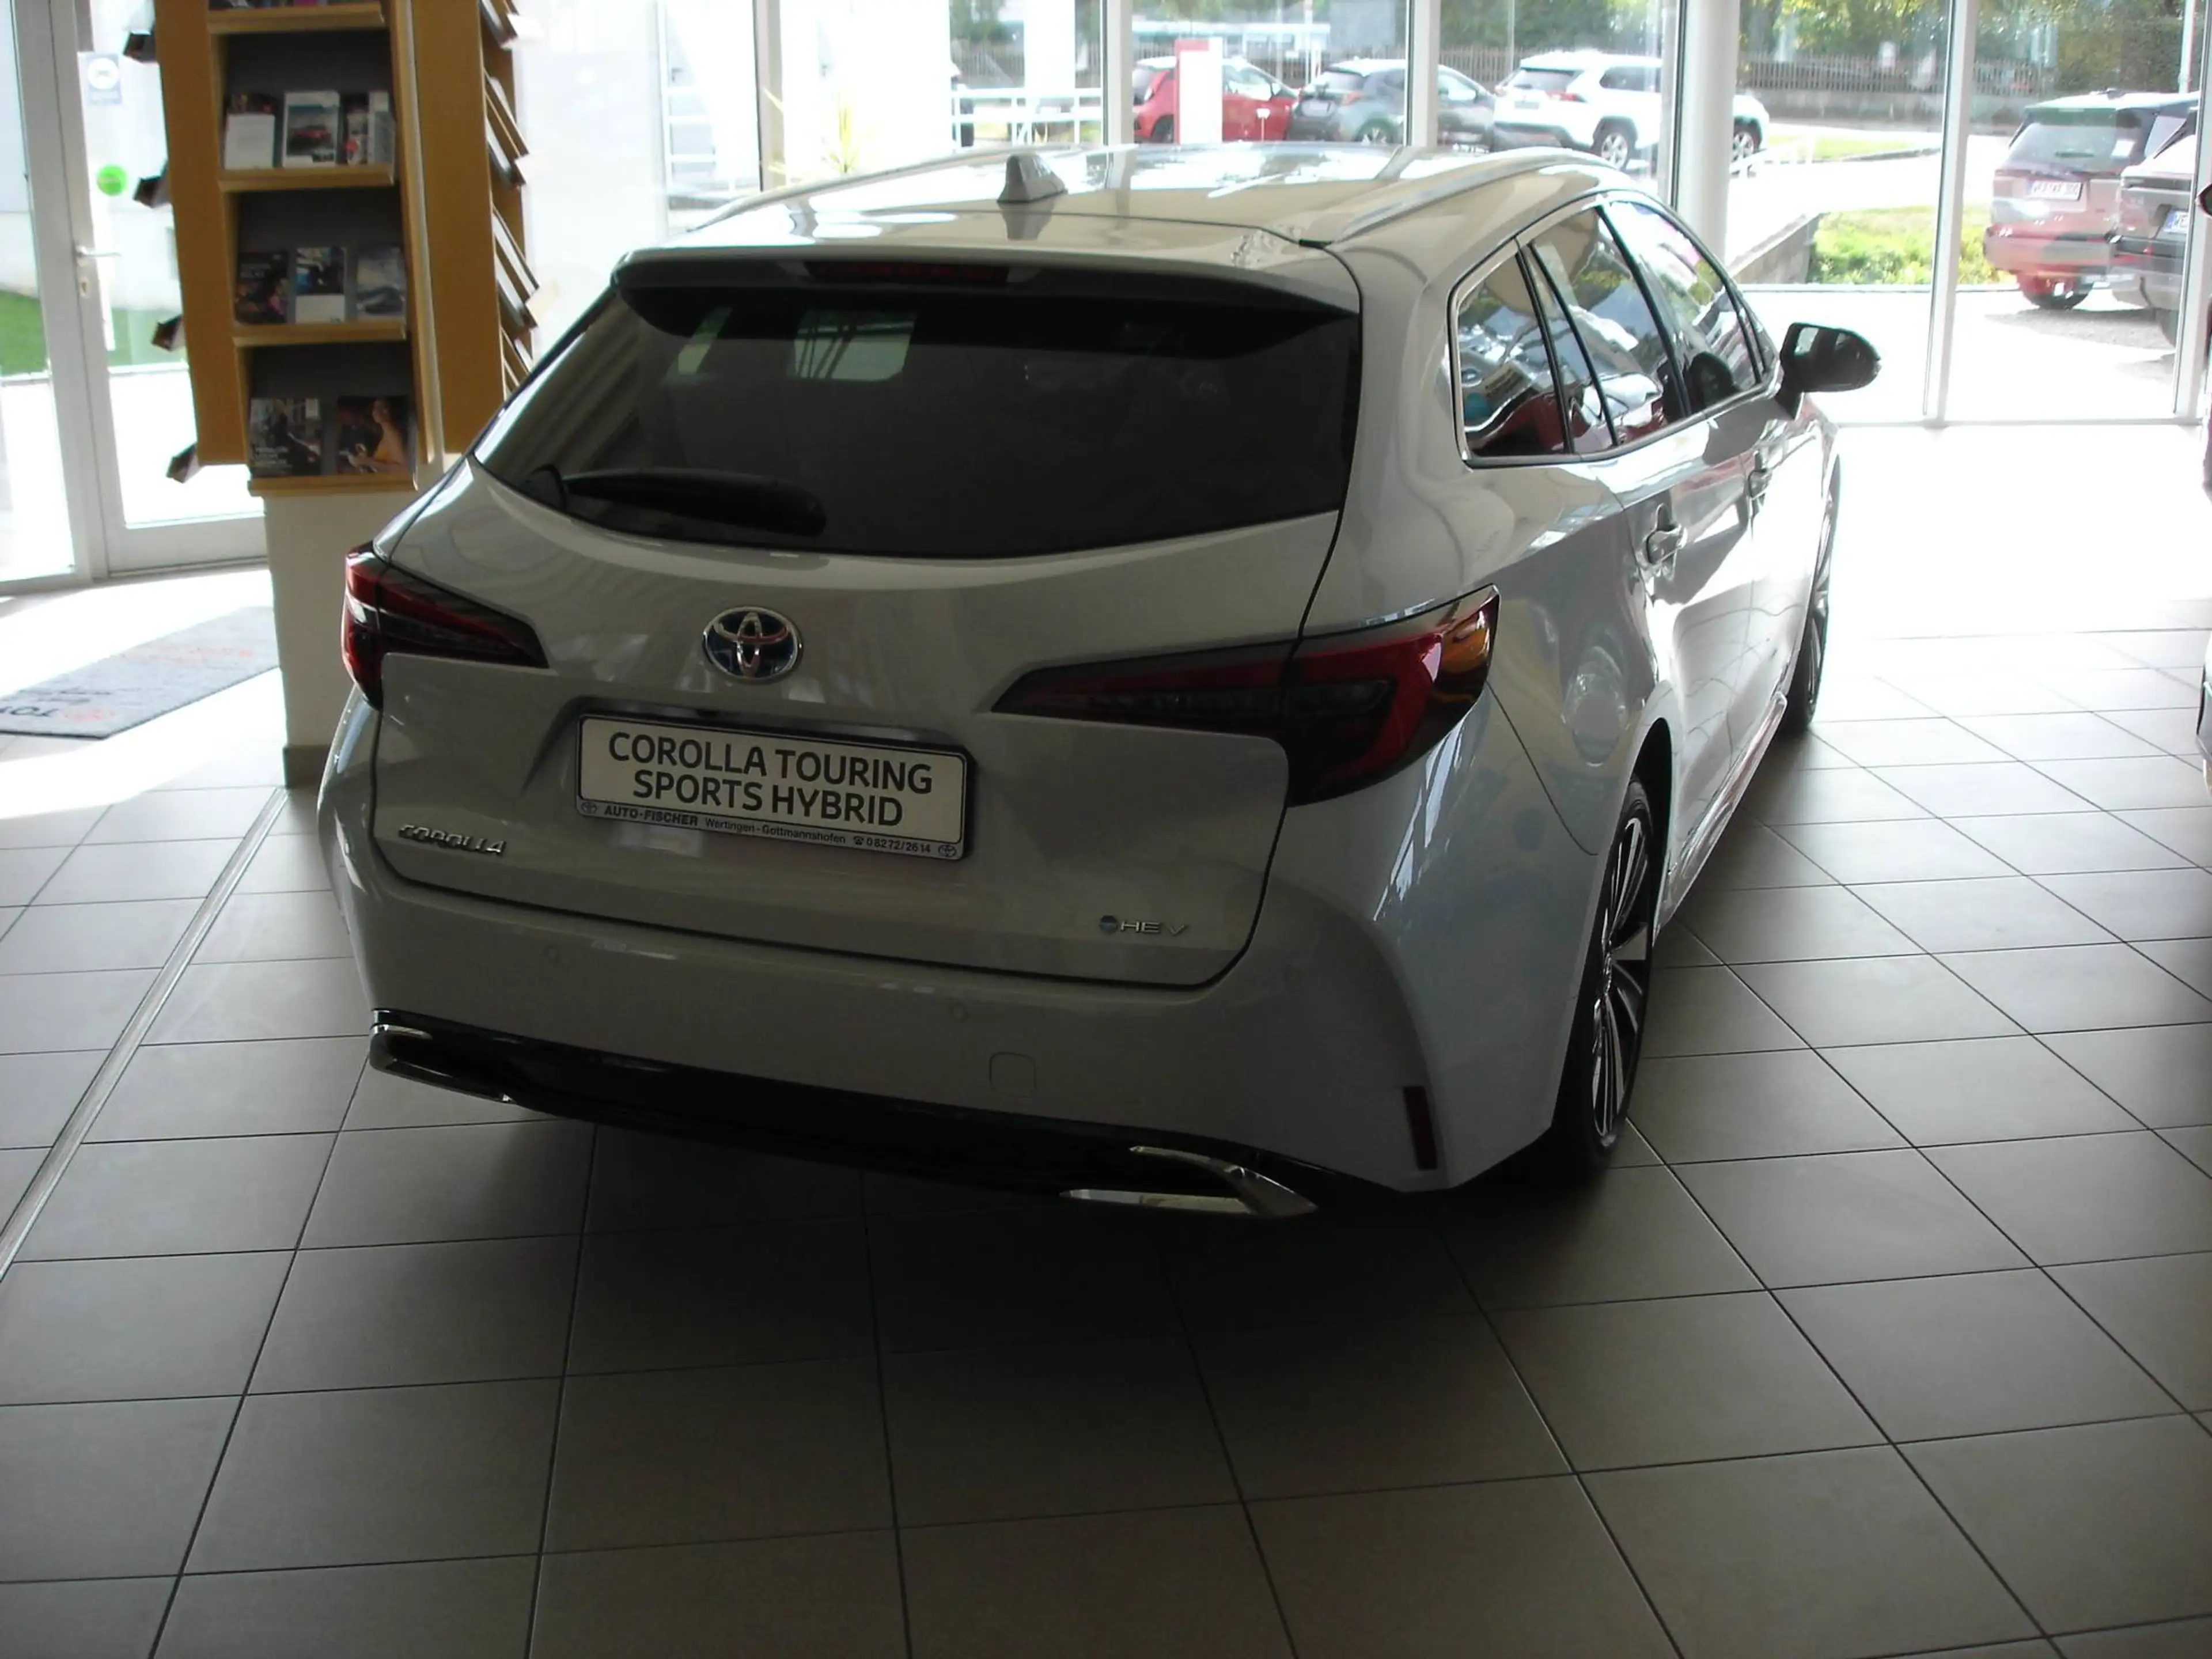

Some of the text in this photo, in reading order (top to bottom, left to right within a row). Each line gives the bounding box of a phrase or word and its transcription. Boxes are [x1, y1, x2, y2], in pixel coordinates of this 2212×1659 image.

[609, 732, 933, 794] COROLLA TOURING
[633, 769, 903, 826] SPORTS HYBRID
[1120, 920, 1187, 937] HEV
